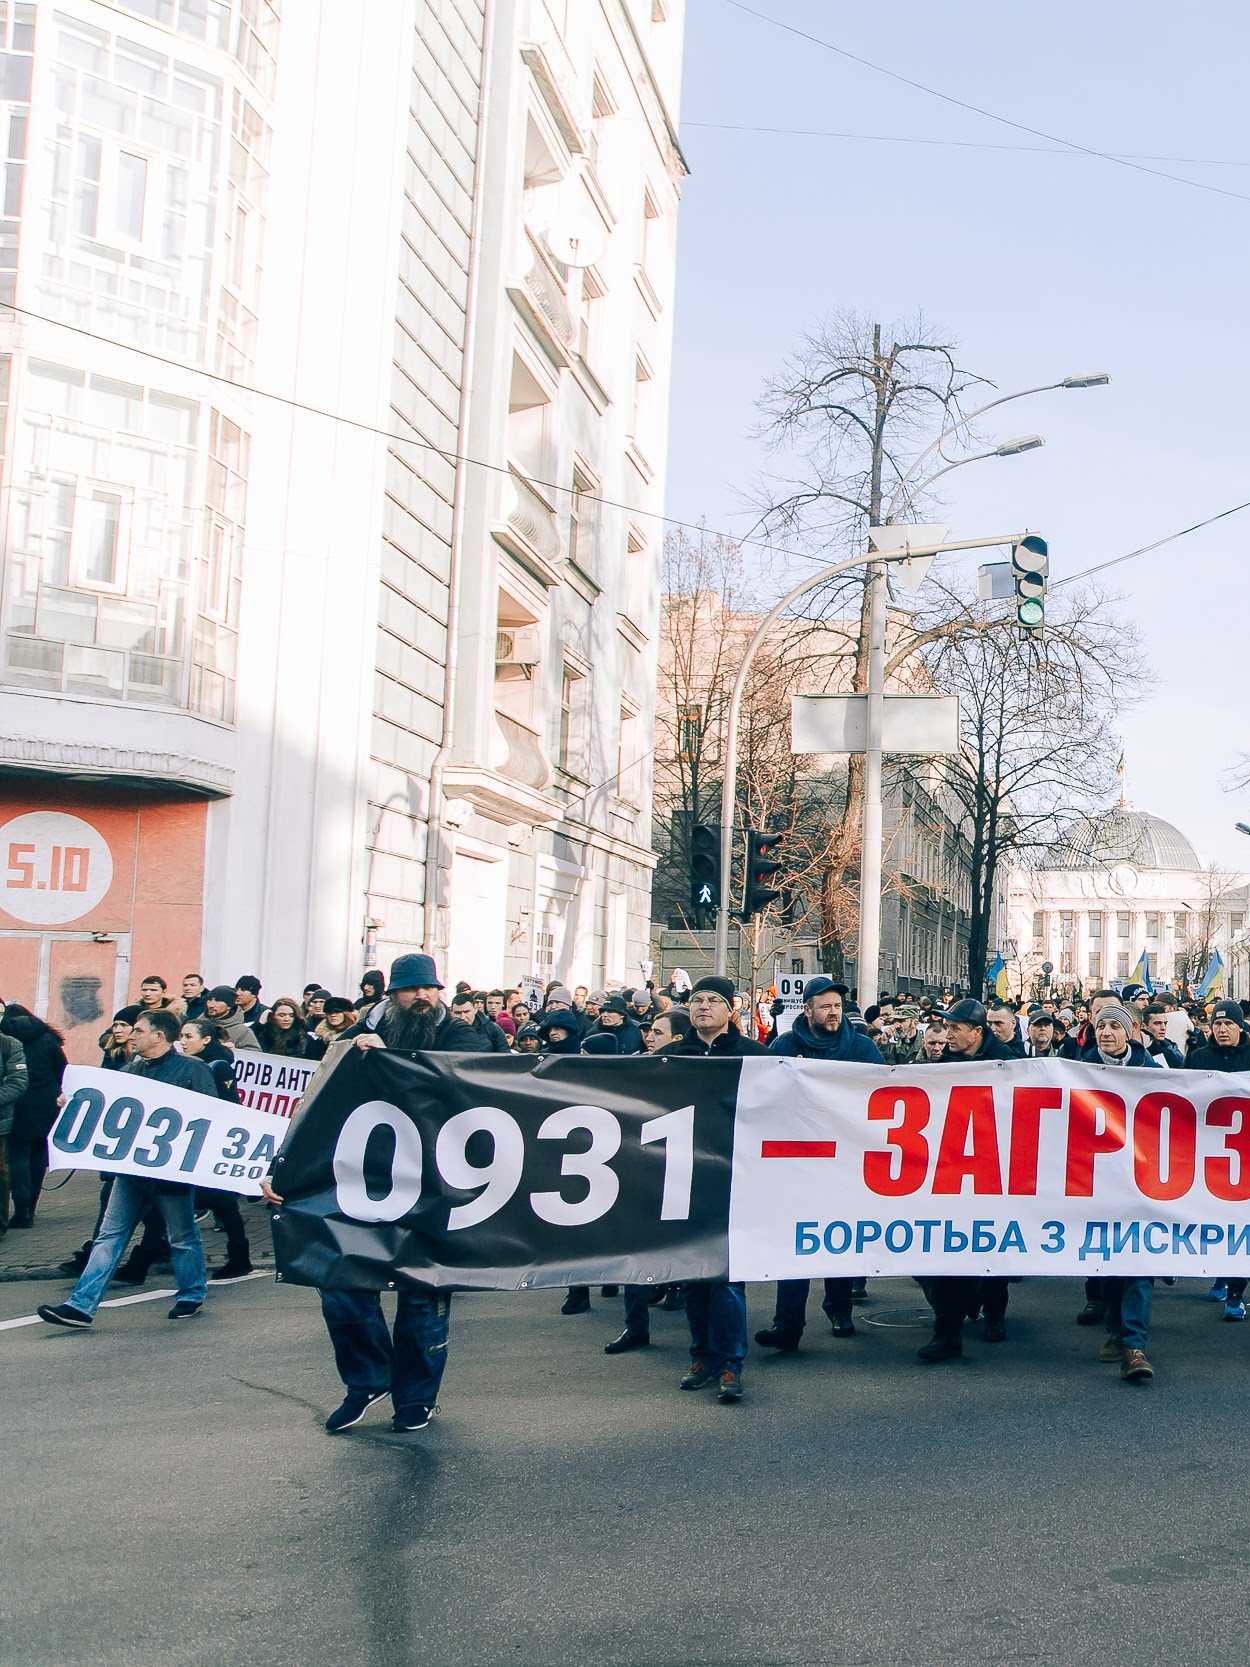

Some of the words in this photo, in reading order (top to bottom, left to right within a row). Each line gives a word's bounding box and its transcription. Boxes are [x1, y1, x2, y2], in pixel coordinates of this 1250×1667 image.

[6, 842, 90, 892] 5.10
[781, 979, 804, 995] 09
[234, 1059, 273, 1086] ОРІВ
[52, 1087, 212, 1173] 0931
[213, 1162, 264, 1180] СВО
[333, 1100, 696, 1232] 0931
[795, 1219, 1028, 1257] БОРОТЬБА
[1041, 1220, 1066, 1253] З
